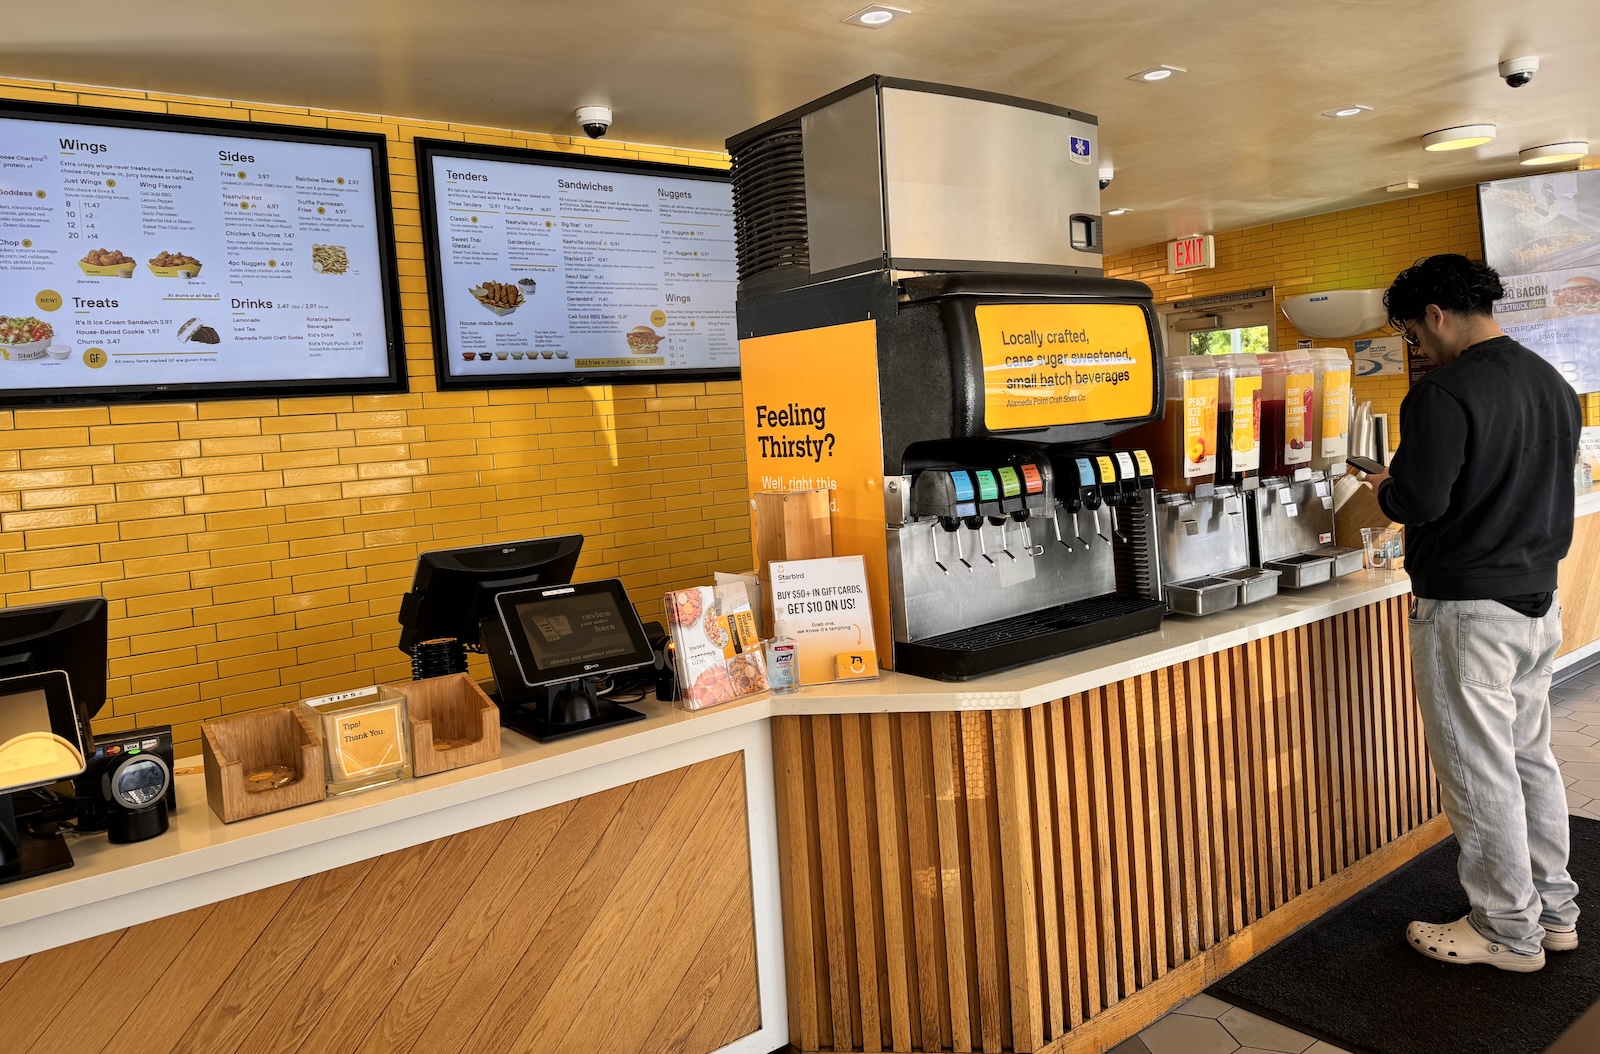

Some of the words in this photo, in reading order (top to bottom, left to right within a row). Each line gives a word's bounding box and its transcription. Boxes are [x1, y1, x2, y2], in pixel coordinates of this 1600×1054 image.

[59, 138, 107, 154] Wings
[218, 150, 255, 163] Sides
[446, 170, 488, 182] Tenders
[558, 179, 614, 192] Sandwiches
[658, 188, 692, 199] Nuggets
[1175, 238, 1203, 267] EXIT
[1517, 276, 1541, 287] GOLD
[1517, 285, 1548, 298] BACON
[72, 297, 119, 308] Treats
[231, 298, 273, 309] Drinks
[665, 294, 691, 303] Wings
[1496, 304, 1505, 312] WE
[1505, 302, 1528, 311] STRUCK
[1001, 330, 1044, 347] Locally
[1047, 329, 1089, 344] crafted,
[18, 349, 46, 359] Starbird
[90, 354, 100, 363] GF
[1005, 355, 1034, 367] cane
[1037, 354, 1068, 368] sugar
[1071, 348, 1132, 364] sweetened,
[1006, 373, 1037, 389] small
[1040, 371, 1072, 386] batch
[1075, 370, 1130, 385] beverages
[1006, 399, 1032, 408] Alameda
[1188, 397, 1206, 406] PEACH
[756, 403, 826, 430] Feeling
[1188, 407, 1201, 416] ICED
[1188, 417, 1199, 427] TEA
[758, 433, 835, 463] Thirsty?
[762, 476, 786, 490] Well,
[816, 476, 837, 490] this
[777, 591, 791, 600] BUY
[792, 589, 811, 599] $50+
[821, 587, 836, 596] GIFT
[838, 585, 863, 595] CARDS,
[788, 602, 804, 615] GET
[807, 600, 822, 614] $10
[825, 599, 838, 611] ON
[840, 598, 856, 610] US!
[581, 610, 611, 620] review
[594, 623, 615, 633] here
[583, 651, 605, 660] another
[605, 647, 625, 656] station
[328, 692, 356, 701] TIPS
[343, 721, 361, 730] Tips!
[344, 732, 368, 742] Thank
